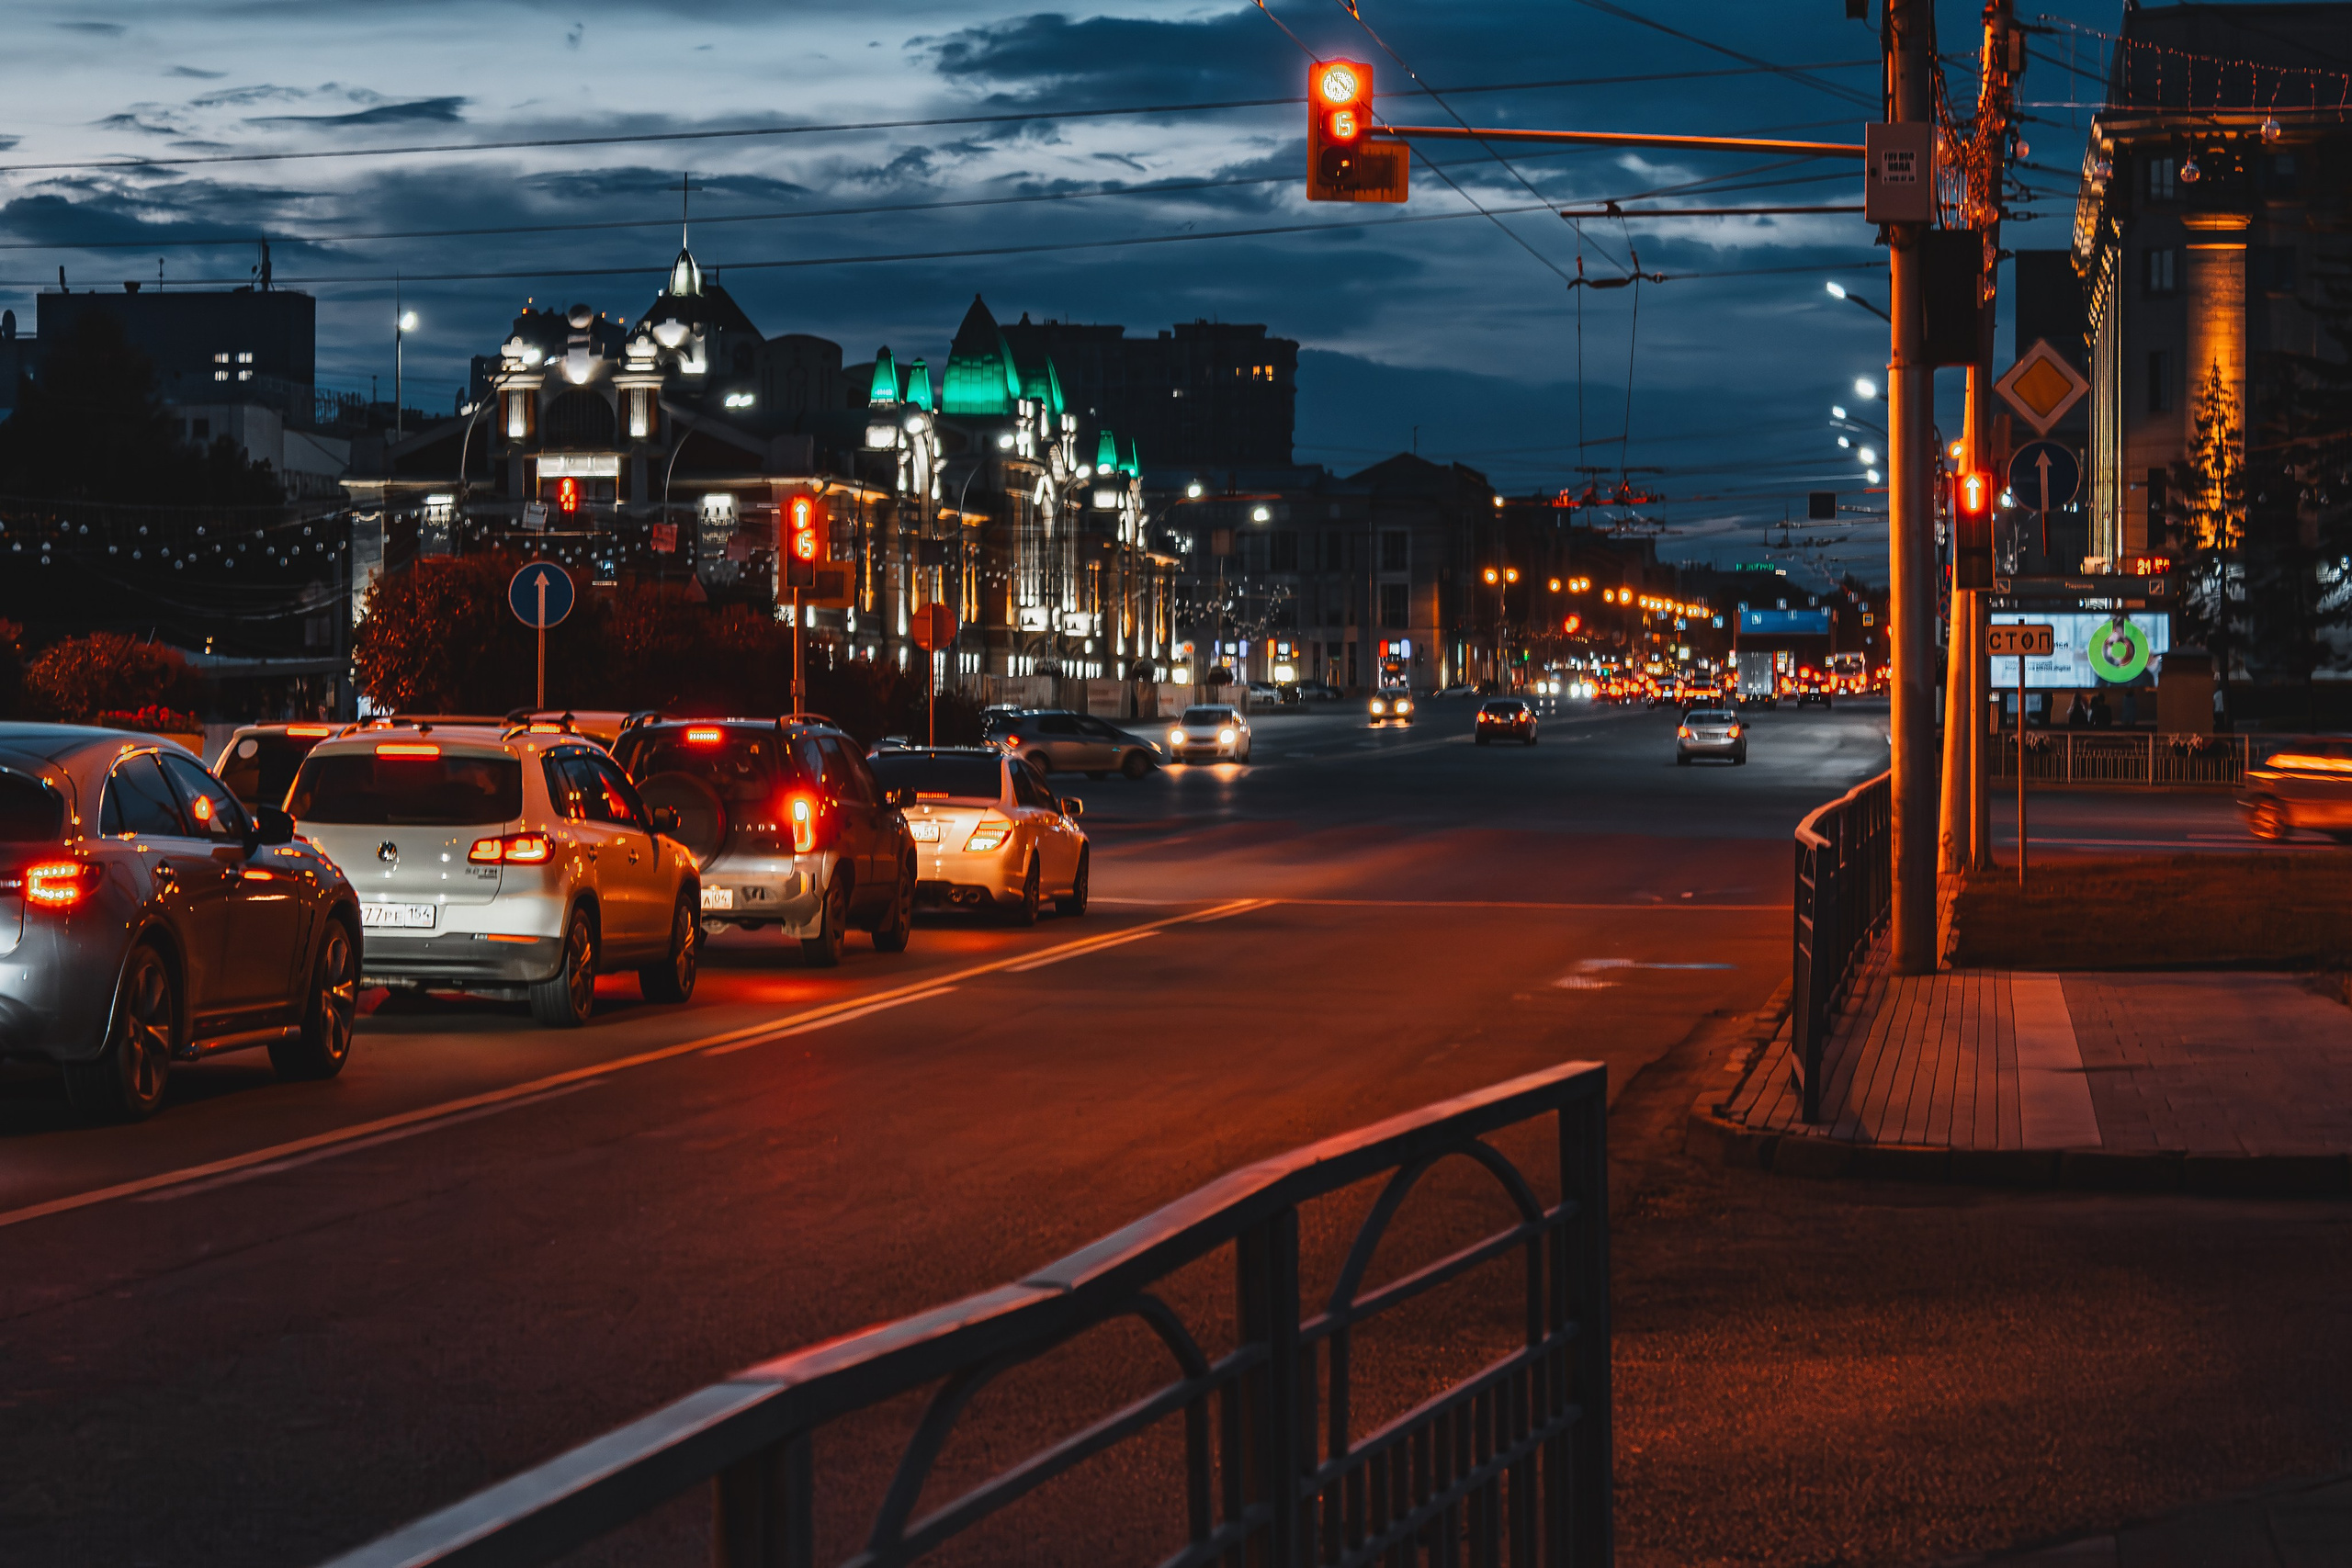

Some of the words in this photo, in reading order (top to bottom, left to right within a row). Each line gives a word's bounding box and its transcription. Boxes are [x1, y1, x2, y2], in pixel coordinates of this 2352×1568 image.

[797, 530, 813, 558] 15
[1989, 631, 2051, 651] СТОП
[408, 907, 430, 920] 154
